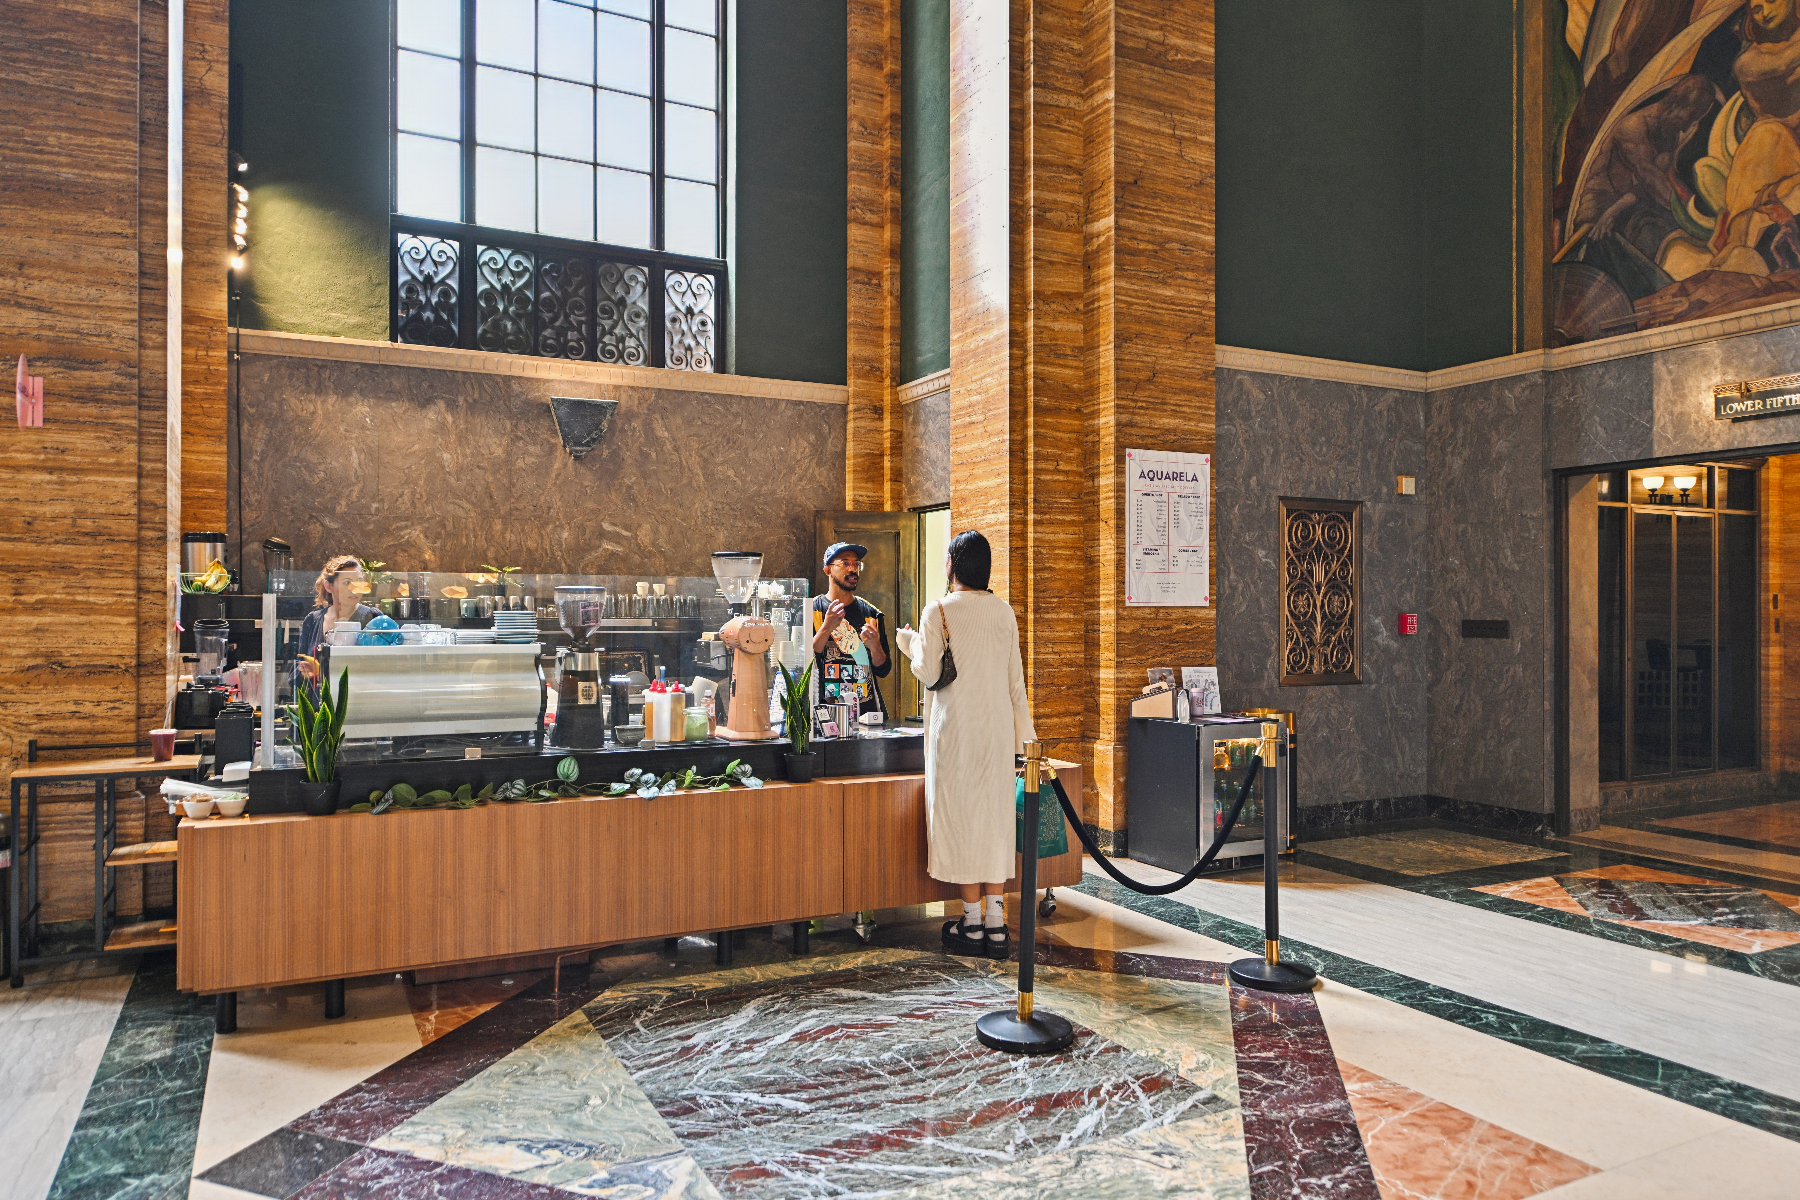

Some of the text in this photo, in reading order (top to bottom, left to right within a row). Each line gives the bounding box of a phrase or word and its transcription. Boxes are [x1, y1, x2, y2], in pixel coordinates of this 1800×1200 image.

[1721, 394, 1800, 414] LOWER FIFTH
[1139, 469, 1199, 482] AQUARELA
